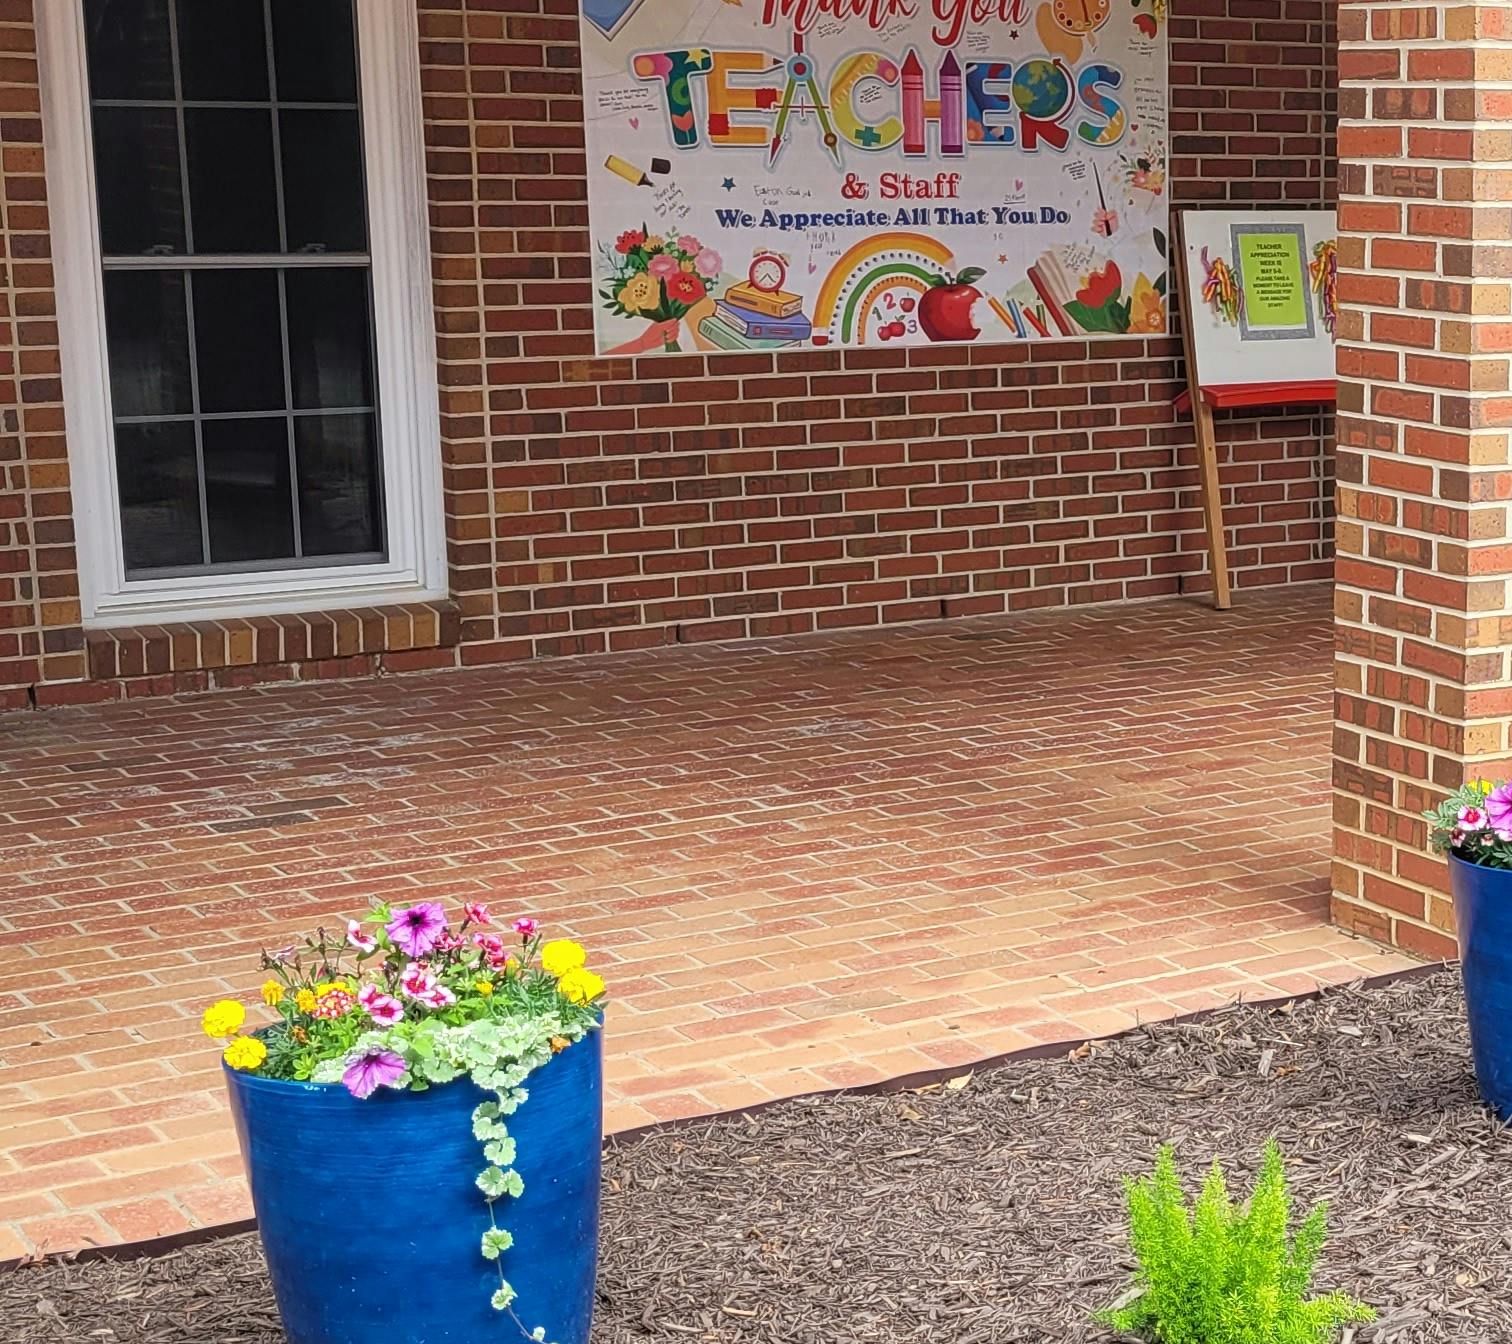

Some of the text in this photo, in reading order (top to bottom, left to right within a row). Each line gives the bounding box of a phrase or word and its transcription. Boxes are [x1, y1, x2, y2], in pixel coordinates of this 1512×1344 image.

[633, 32, 1123, 168] TEACHERS
[841, 173, 869, 199] &
[879, 172, 960, 200] Staff
[716, 206, 1071, 231] We Appreciate All That You Do
[883, 292, 896, 309] 2
[907, 319, 917, 334] 3
